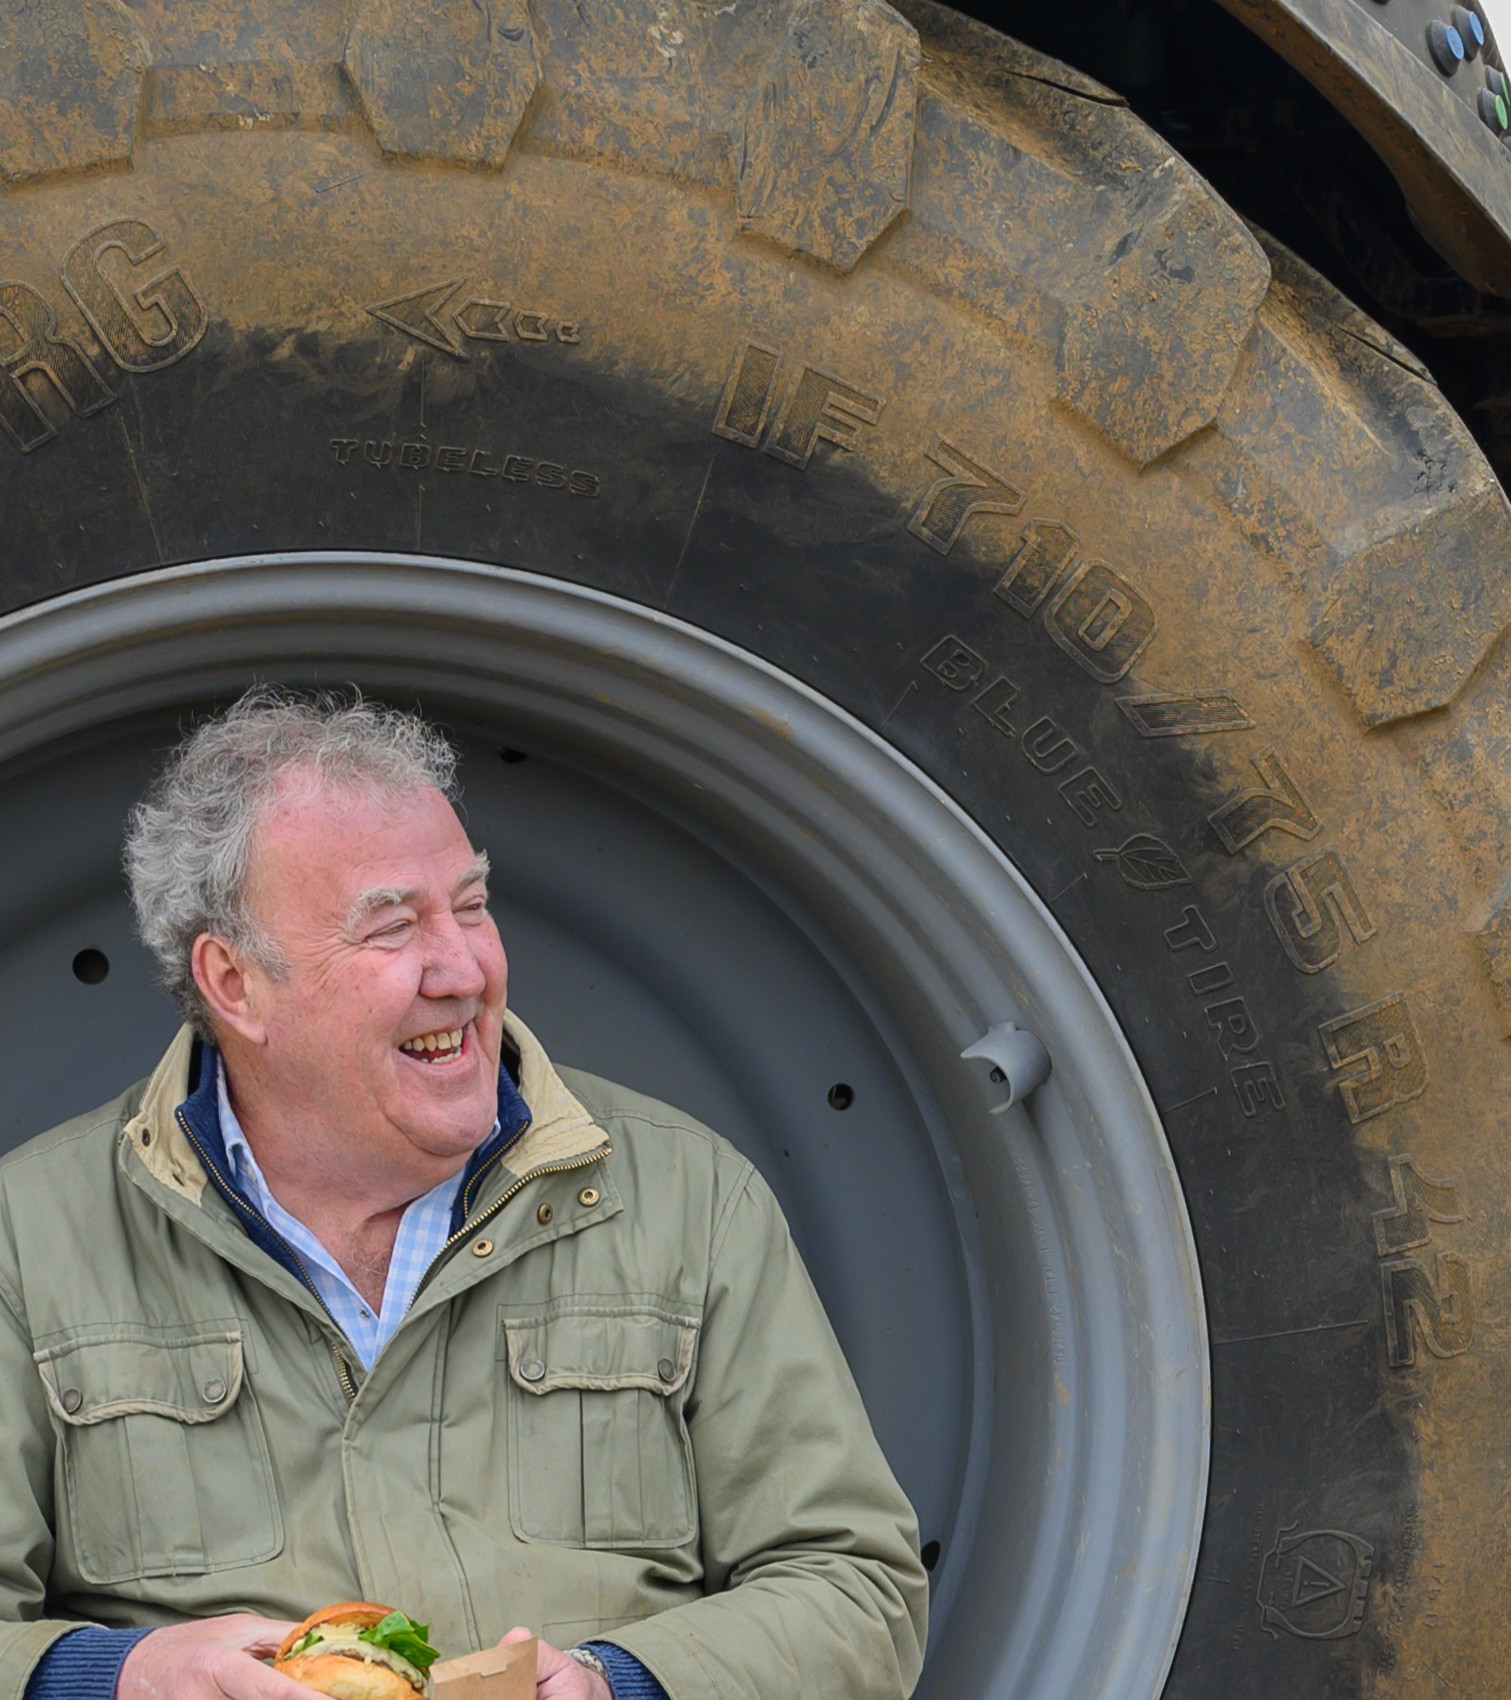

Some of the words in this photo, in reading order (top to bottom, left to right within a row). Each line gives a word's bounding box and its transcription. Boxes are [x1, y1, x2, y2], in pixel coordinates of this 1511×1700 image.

[329, 438, 601, 497] TUBELESS
[711, 338, 888, 470] IF
[907, 432, 1377, 975] 710/75
[920, 634, 1124, 828] BLUE
[1163, 904, 1287, 1119] TIRE
